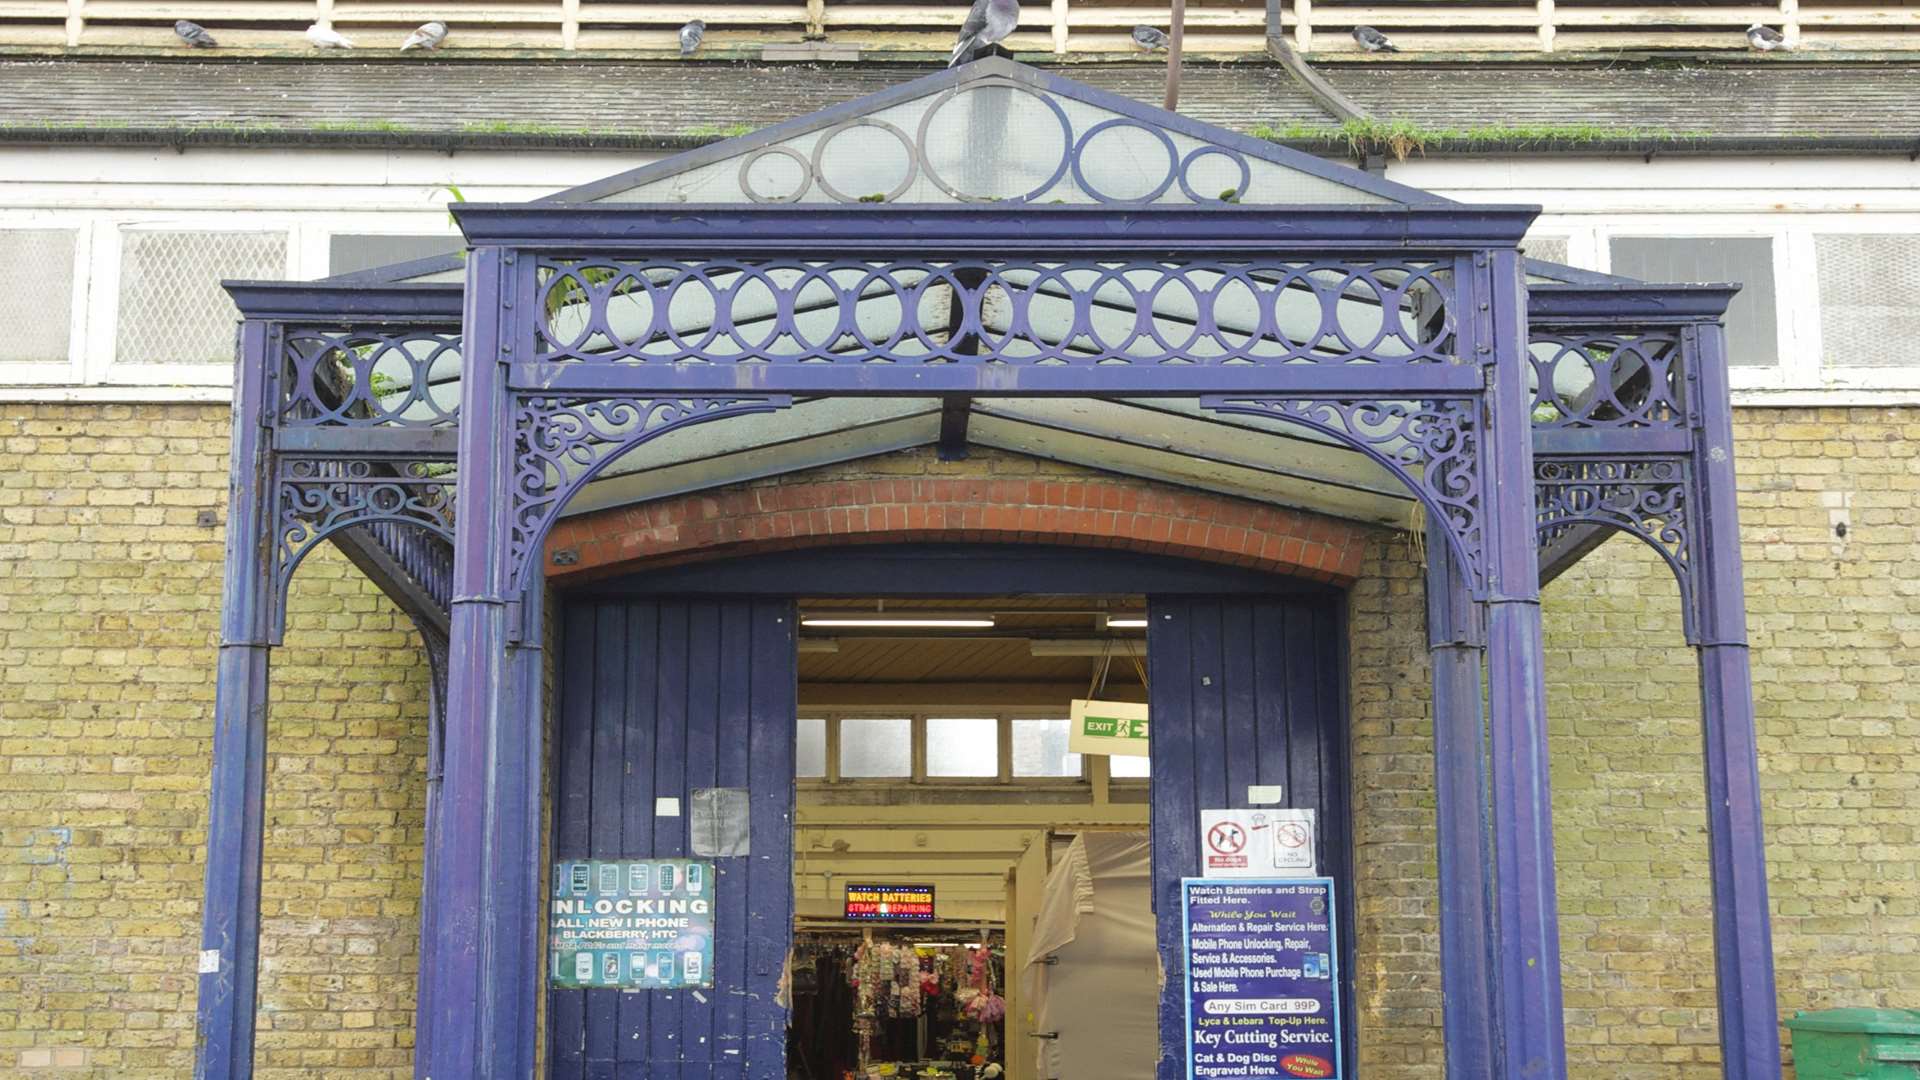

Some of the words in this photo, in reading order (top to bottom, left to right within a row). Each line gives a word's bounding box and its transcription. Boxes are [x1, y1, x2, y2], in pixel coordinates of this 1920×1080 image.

[1087, 721, 1114, 731] EXIT
[1189, 887, 1223, 895] Watch
[1226, 887, 1273, 895] Batteries
[1298, 886, 1326, 896] Strap
[848, 892, 880, 902] WATCH
[882, 893, 932, 902] BATTERIES
[1190, 896, 1220, 904] Fitted
[1223, 896, 1251, 904] Here.
[888, 903, 932, 913] REPAIRING
[1209, 911, 1242, 919] While
[1244, 911, 1266, 920] You
[1270, 910, 1296, 919] Wait
[556, 918, 584, 928] ALL
[588, 918, 623, 928] NEW
[627, 918, 631, 927] I
[635, 918, 689, 928] PHONE
[1192, 923, 1237, 932] Alternation
[1239, 923, 1245, 932] &
[1247, 923, 1273, 934] Repair
[1275, 923, 1305, 932] Service
[1307, 922, 1328, 931] Here.
[563, 930, 648, 940] BLACKBERRY,
[652, 930, 678, 938] HTC
[1192, 939, 1217, 949] Mobile
[1218, 939, 1242, 949] Phone
[1243, 938, 1283, 951] Unlocking,
[1285, 938, 1311, 950] Repair,
[1192, 953, 1220, 964] Service
[1222, 954, 1228, 963] &
[1229, 953, 1277, 963] Accessories.
[1193, 967, 1212, 978] Used
[1214, 967, 1238, 978] Mobile
[1240, 967, 1263, 978] Phone
[1193, 982, 1200, 992] &
[1201, 982, 1217, 992] Sale
[1219, 982, 1239, 992] Here.
[1208, 1002, 1231, 1012] Any
[1235, 1001, 1256, 1010] Sim
[1260, 1001, 1287, 1010] Card
[1294, 1002, 1316, 1010] 99P
[1198, 1017, 1221, 1027] Lyca
[1223, 1017, 1229, 1025] &
[1232, 1017, 1264, 1025] Lebara
[1268, 1017, 1302, 1026] Top-Up
[1304, 1016, 1328, 1025] Here.
[1195, 1030, 1221, 1048] Key
[1224, 1029, 1277, 1048] Cutting
[1280, 1029, 1333, 1043] Service.
[1195, 1053, 1214, 1063] Cat
[1216, 1053, 1225, 1062] &
[1227, 1053, 1249, 1065] Dog
[1252, 1053, 1277, 1062] Disc
[1195, 1066, 1247, 1078] Engraved
[1249, 1066, 1279, 1075] Here.
[1287, 1063, 1304, 1072] You
[1304, 1066, 1324, 1077] Wait
